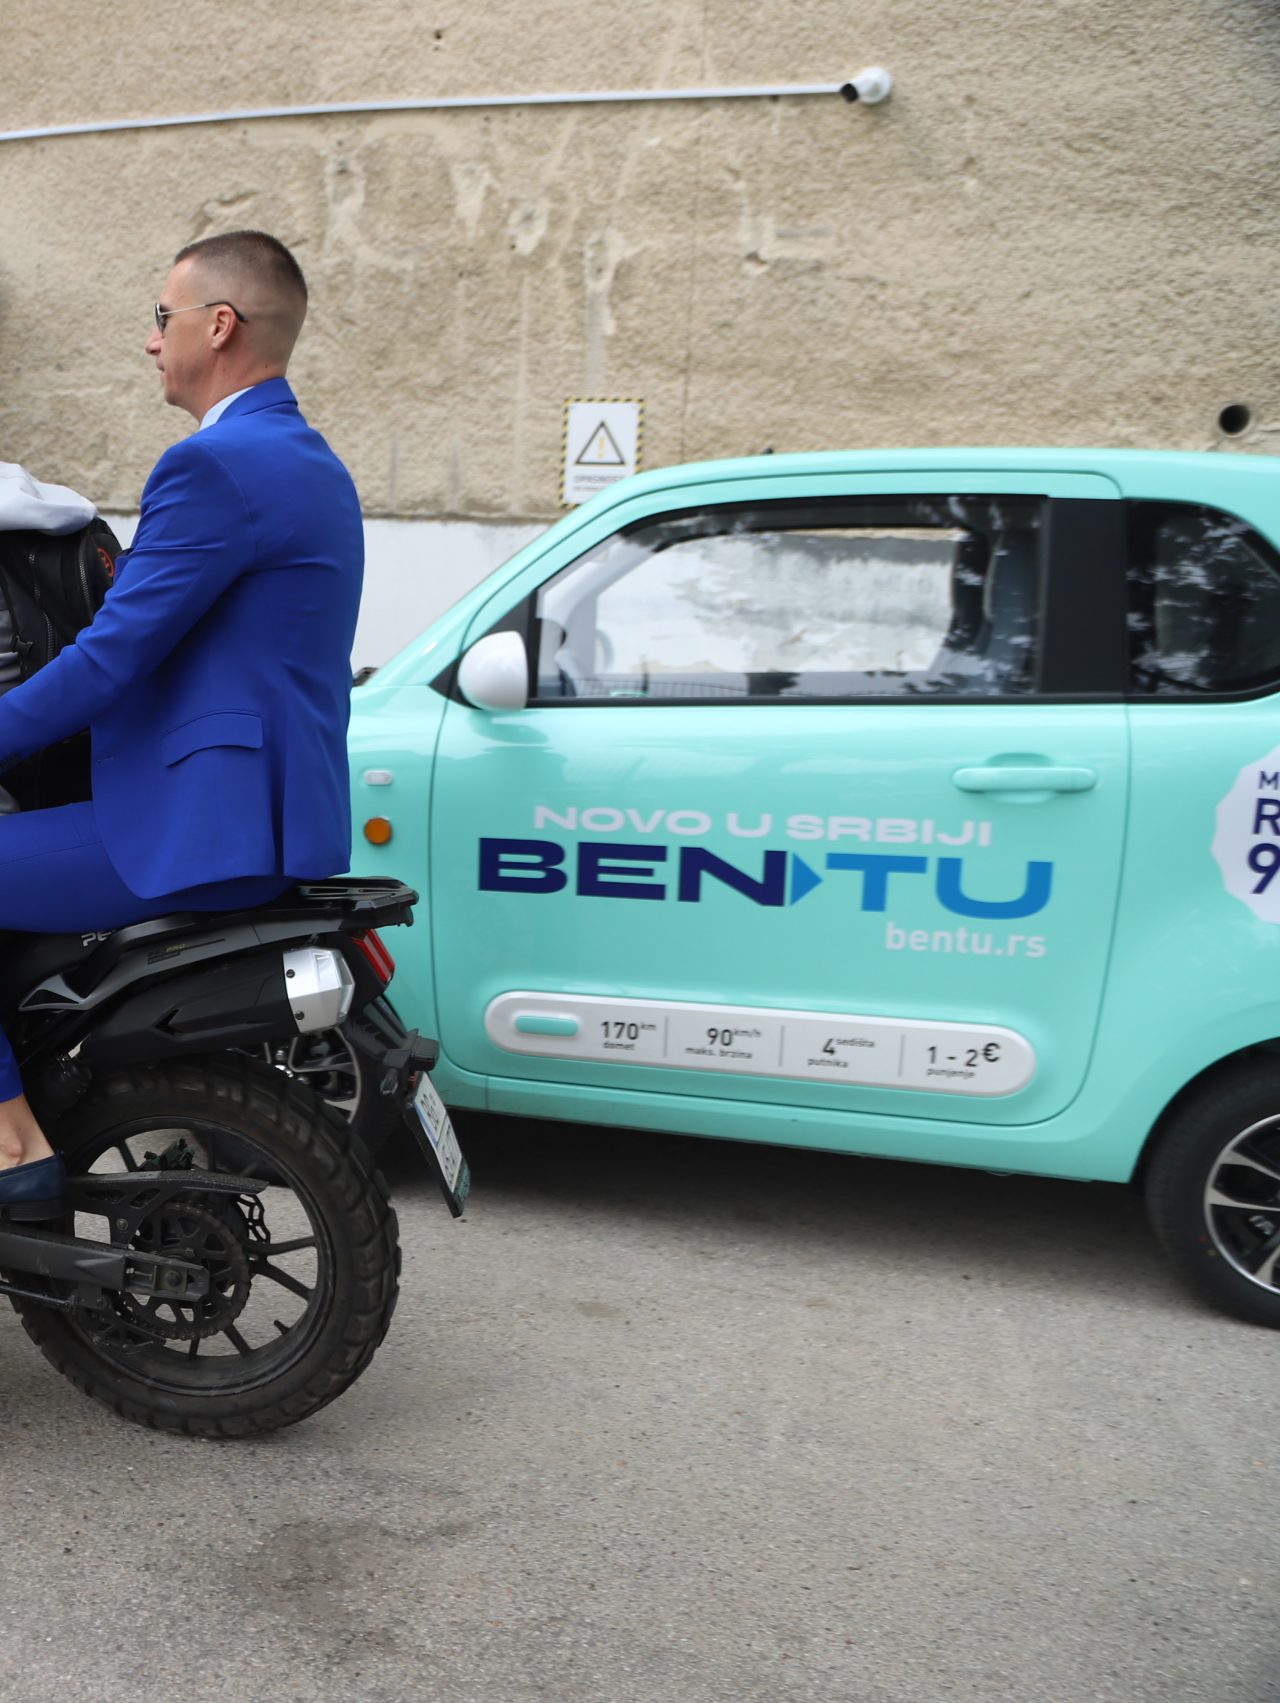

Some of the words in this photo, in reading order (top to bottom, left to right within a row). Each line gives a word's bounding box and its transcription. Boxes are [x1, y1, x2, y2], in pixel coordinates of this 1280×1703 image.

[533, 805, 712, 836] NOVO
[726, 812, 772, 838] U
[785, 814, 992, 847] SRBIJI
[1251, 797, 1280, 836] R
[1246, 842, 1280, 894] 9
[885, 921, 1047, 958] bentu.rs
[601, 1021, 639, 1040] 170
[706, 1027, 734, 1047] 90
[822, 1037, 836, 1056] 4
